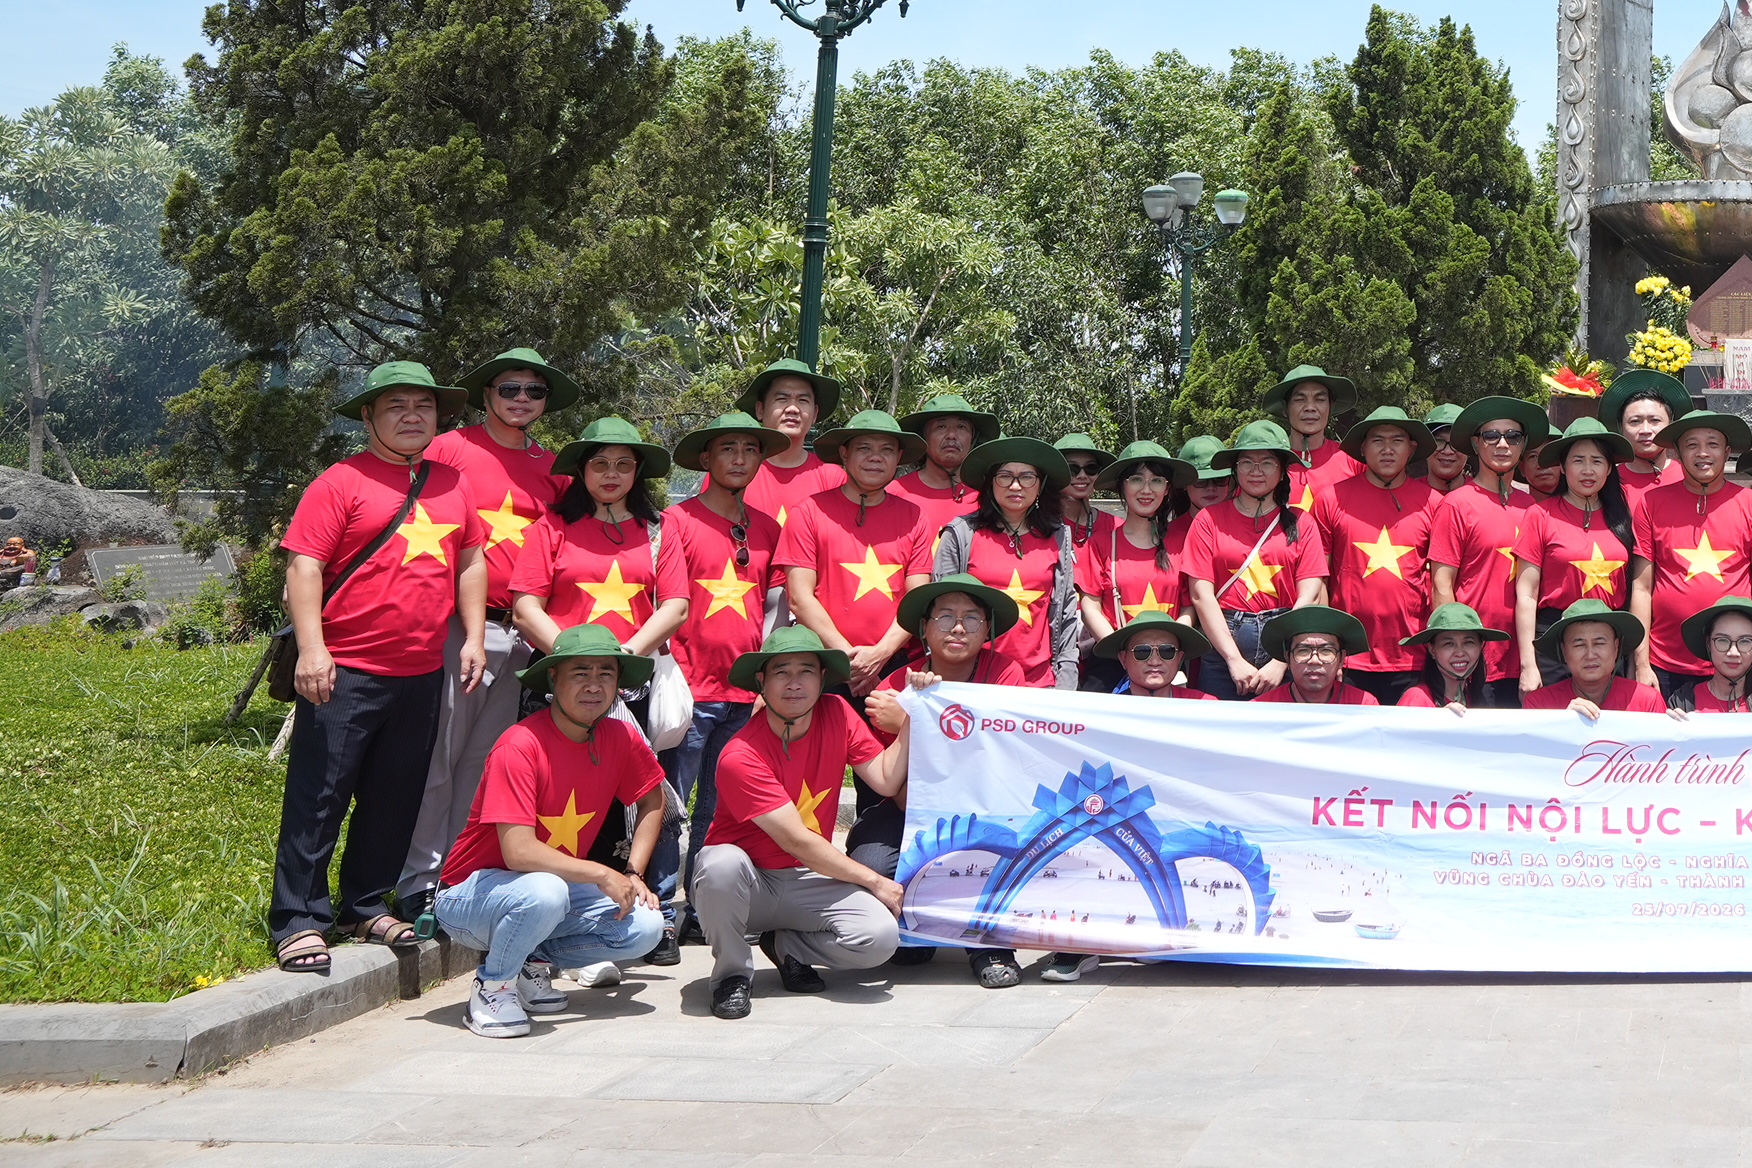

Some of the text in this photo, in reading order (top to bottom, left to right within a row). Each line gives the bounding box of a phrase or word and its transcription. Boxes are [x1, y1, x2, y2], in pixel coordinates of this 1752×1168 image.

[981, 718, 1086, 734] PSD GROUP
[1564, 740, 1668, 787] Hành
[1675, 748, 1750, 786] trình
[1311, 786, 1393, 828] KẾT
[1411, 791, 1487, 831] NỐI
[1507, 797, 1582, 842] NỘI
[1602, 803, 1681, 843] LỰC
[1470, 850, 1513, 867] NGÃ
[1520, 853, 1548, 868] BA
[1557, 851, 1614, 868] ĐỒNG
[1621, 852, 1662, 871] LỘC
[1685, 853, 1749, 869] NGHĨA
[1433, 868, 1490, 886] VŨNG
[1497, 870, 1555, 887] CHÙA
[1561, 870, 1606, 888] ĐẢO
[1613, 870, 1653, 888] YẾN
[1676, 871, 1745, 889] THÀNH
[1632, 902, 1746, 917] 25/07/2026
